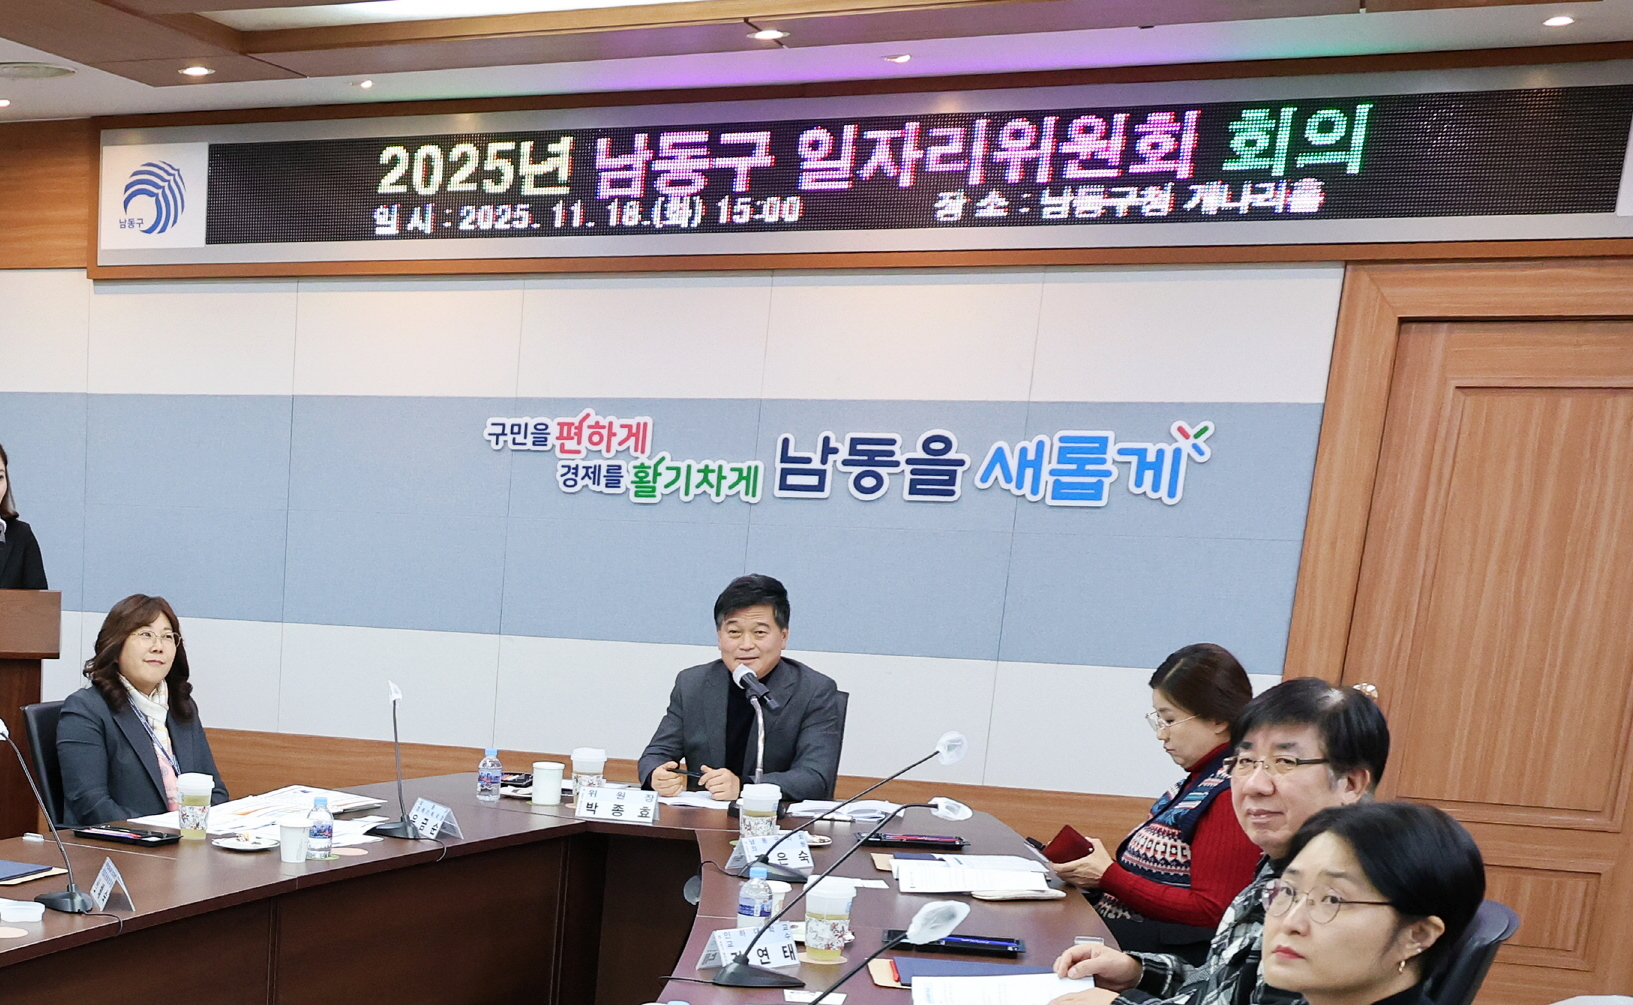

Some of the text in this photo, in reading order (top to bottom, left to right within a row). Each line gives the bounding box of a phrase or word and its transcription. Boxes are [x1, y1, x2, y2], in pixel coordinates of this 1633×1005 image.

[377, 103, 1375, 199] 2025년 남동구 일자리위원회 회의
[119, 218, 144, 229] 남동구
[1040, 182, 1175, 220] 남동구청
[487, 409, 649, 454] 구민을 편하게
[560, 431, 1183, 502] 경제를 활기차게 남동을 새롭게
